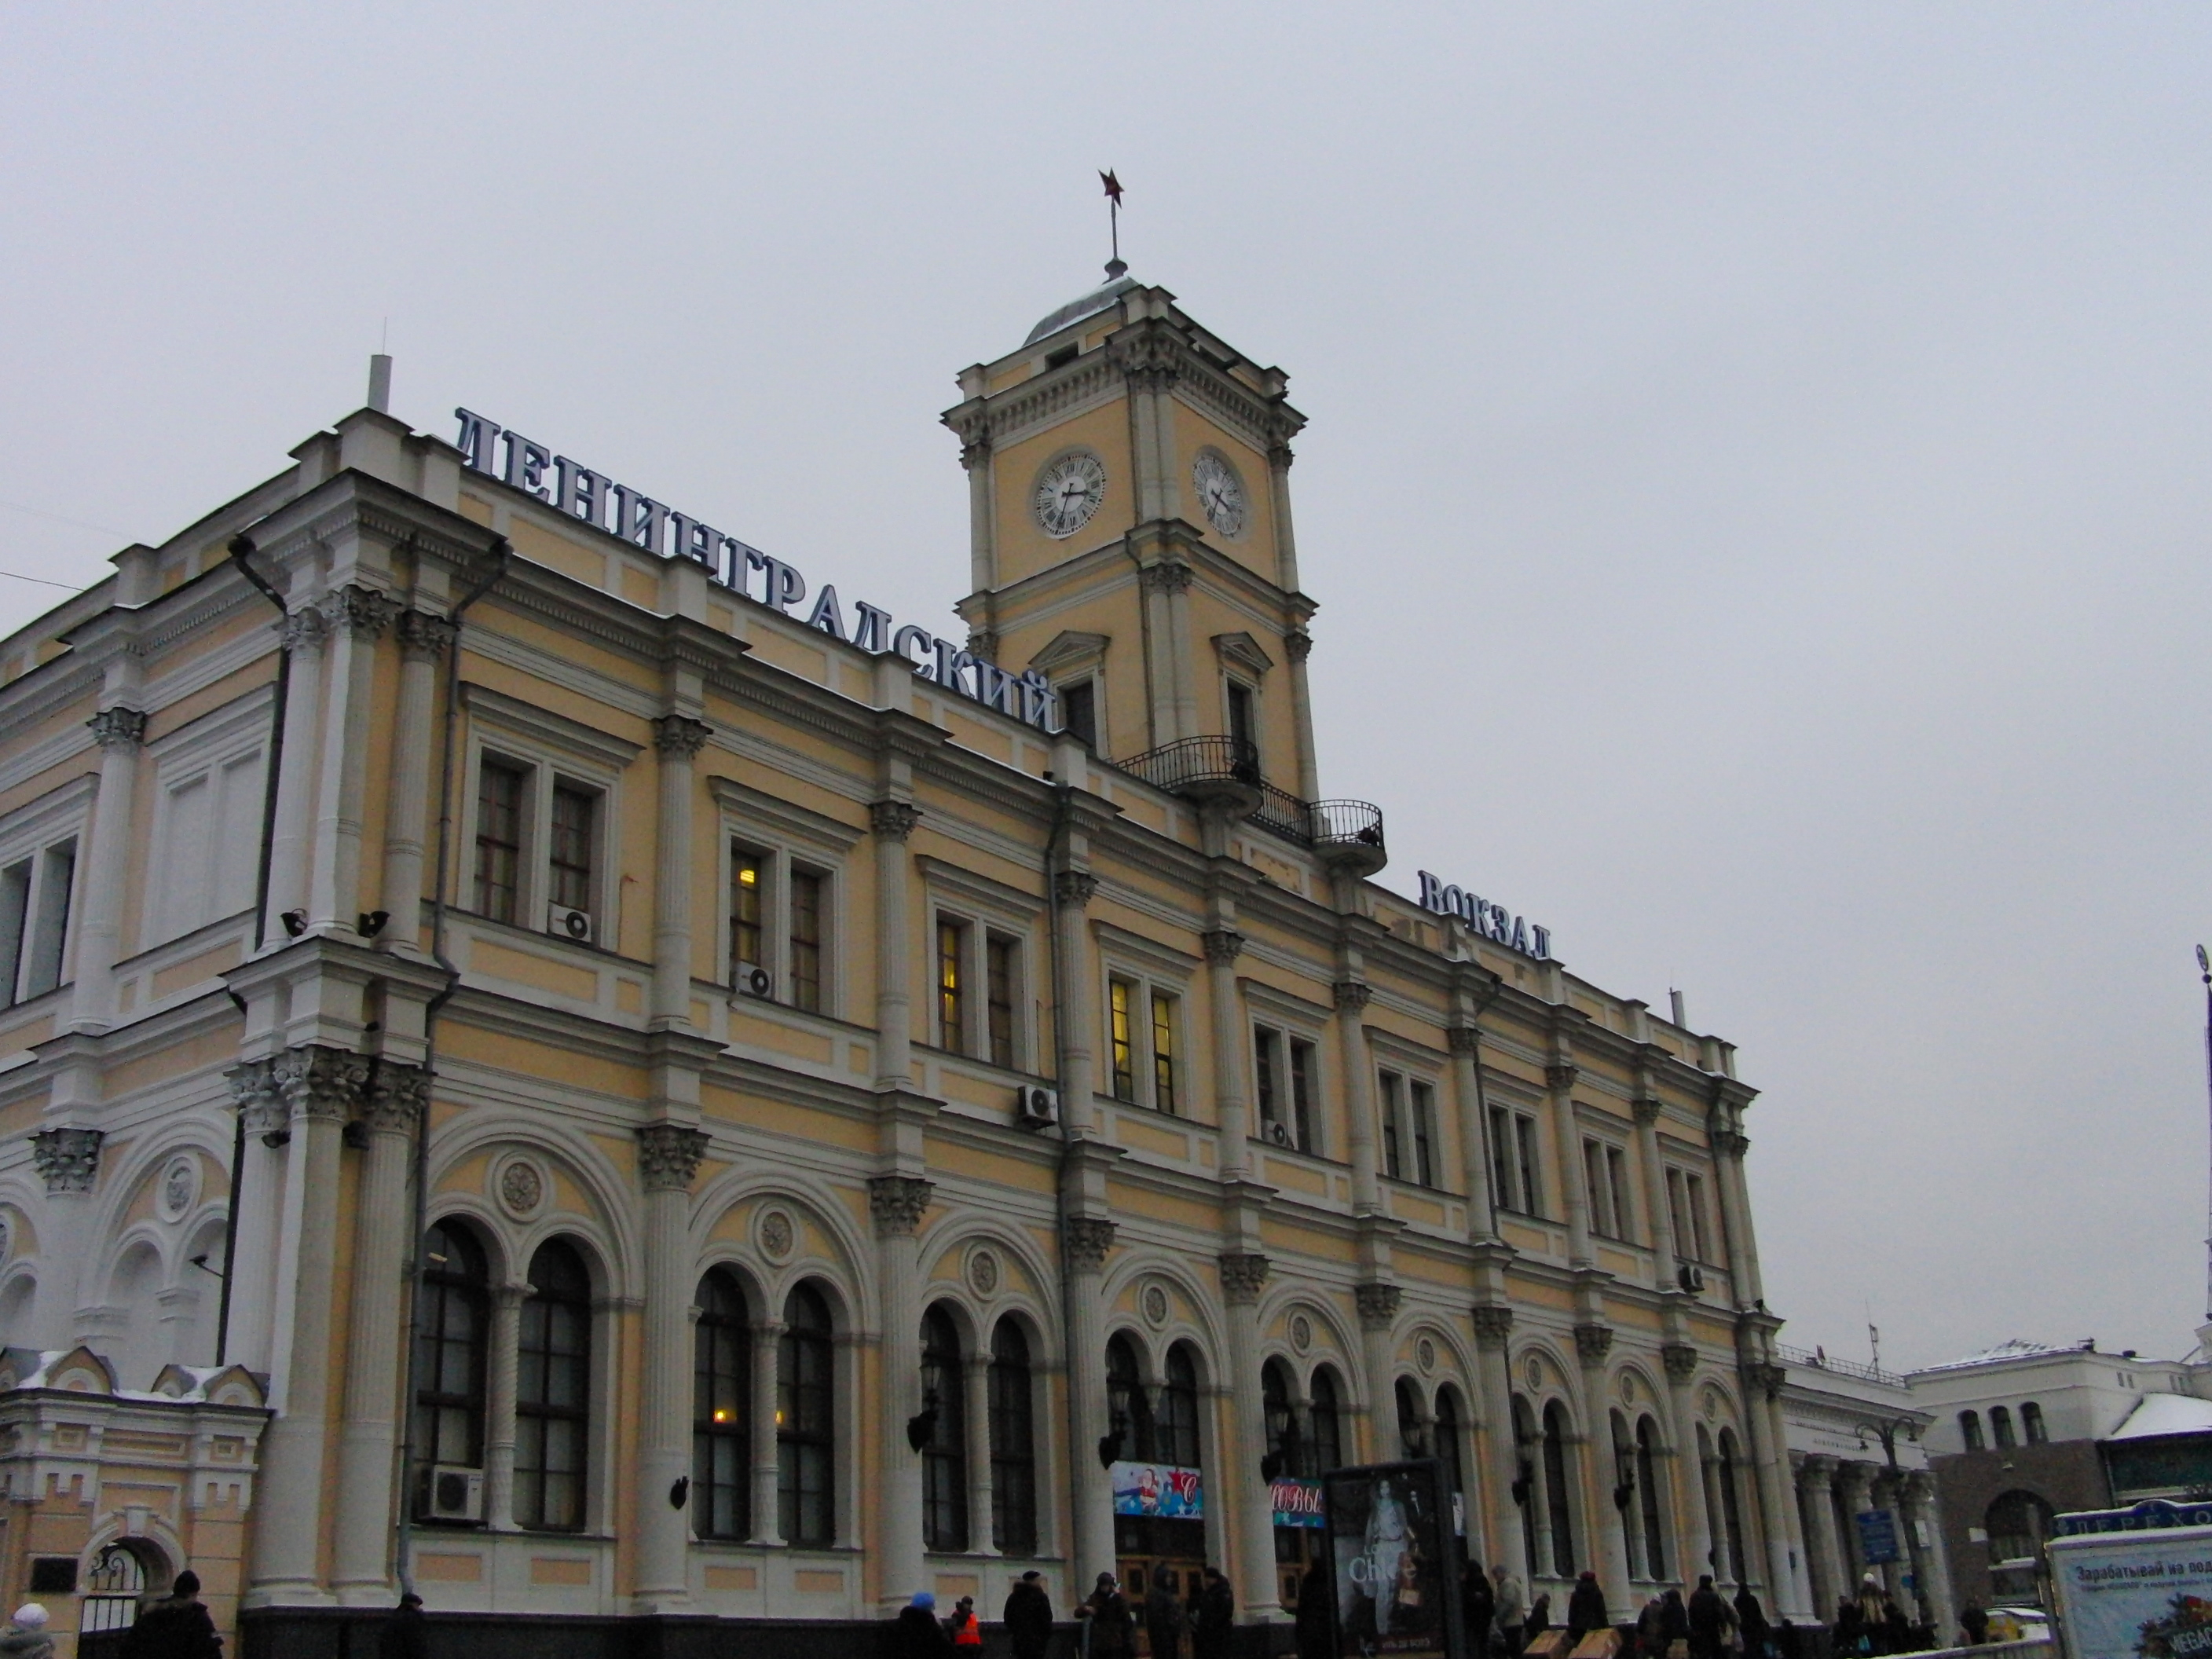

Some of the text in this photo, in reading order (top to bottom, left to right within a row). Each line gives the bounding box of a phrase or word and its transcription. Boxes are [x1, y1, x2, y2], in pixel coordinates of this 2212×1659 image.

[454, 407, 1058, 734] ЛЕНИНГРАДСКИЙ
[1417, 870, 1551, 960] ВОКЗАЛ
[2075, 1560, 2164, 1583] Зарабатывай
